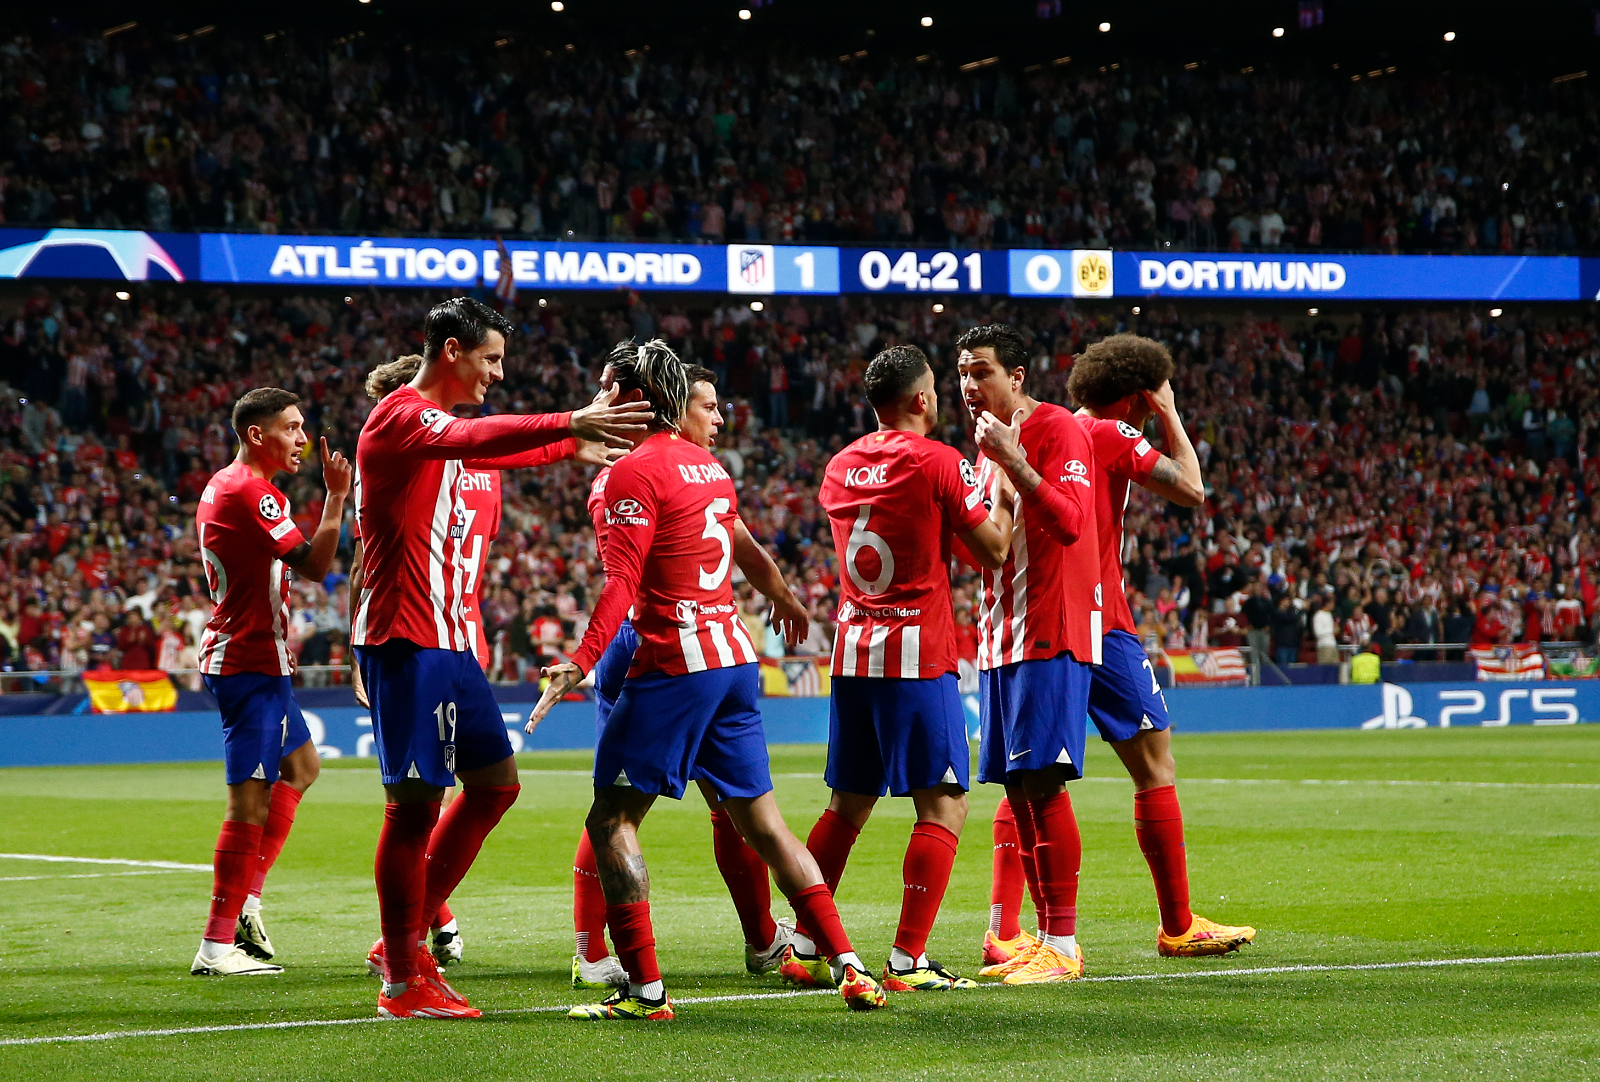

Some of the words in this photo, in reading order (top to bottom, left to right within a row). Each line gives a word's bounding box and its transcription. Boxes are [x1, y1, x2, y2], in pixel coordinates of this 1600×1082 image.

[269, 240, 478, 280] ATLÉTICO
[483, 249, 539, 281] DE
[544, 251, 702, 283] MADRID
[794, 251, 814, 289] 1
[859, 250, 982, 290] 04:21
[1025, 254, 1061, 293] 0
[1140, 260, 1347, 290] DORTMUND
[461, 472, 492, 491] ENTE
[592, 474, 609, 495] AZ
[845, 464, 888, 487] KOKE
[699, 498, 731, 591] 5
[846, 504, 894, 596] 6
[699, 605, 717, 615] Save
[882, 607, 921, 617] Children
[433, 701, 457, 742] 19
[1439, 688, 1580, 728] PS5
[280, 714, 289, 747] 1
